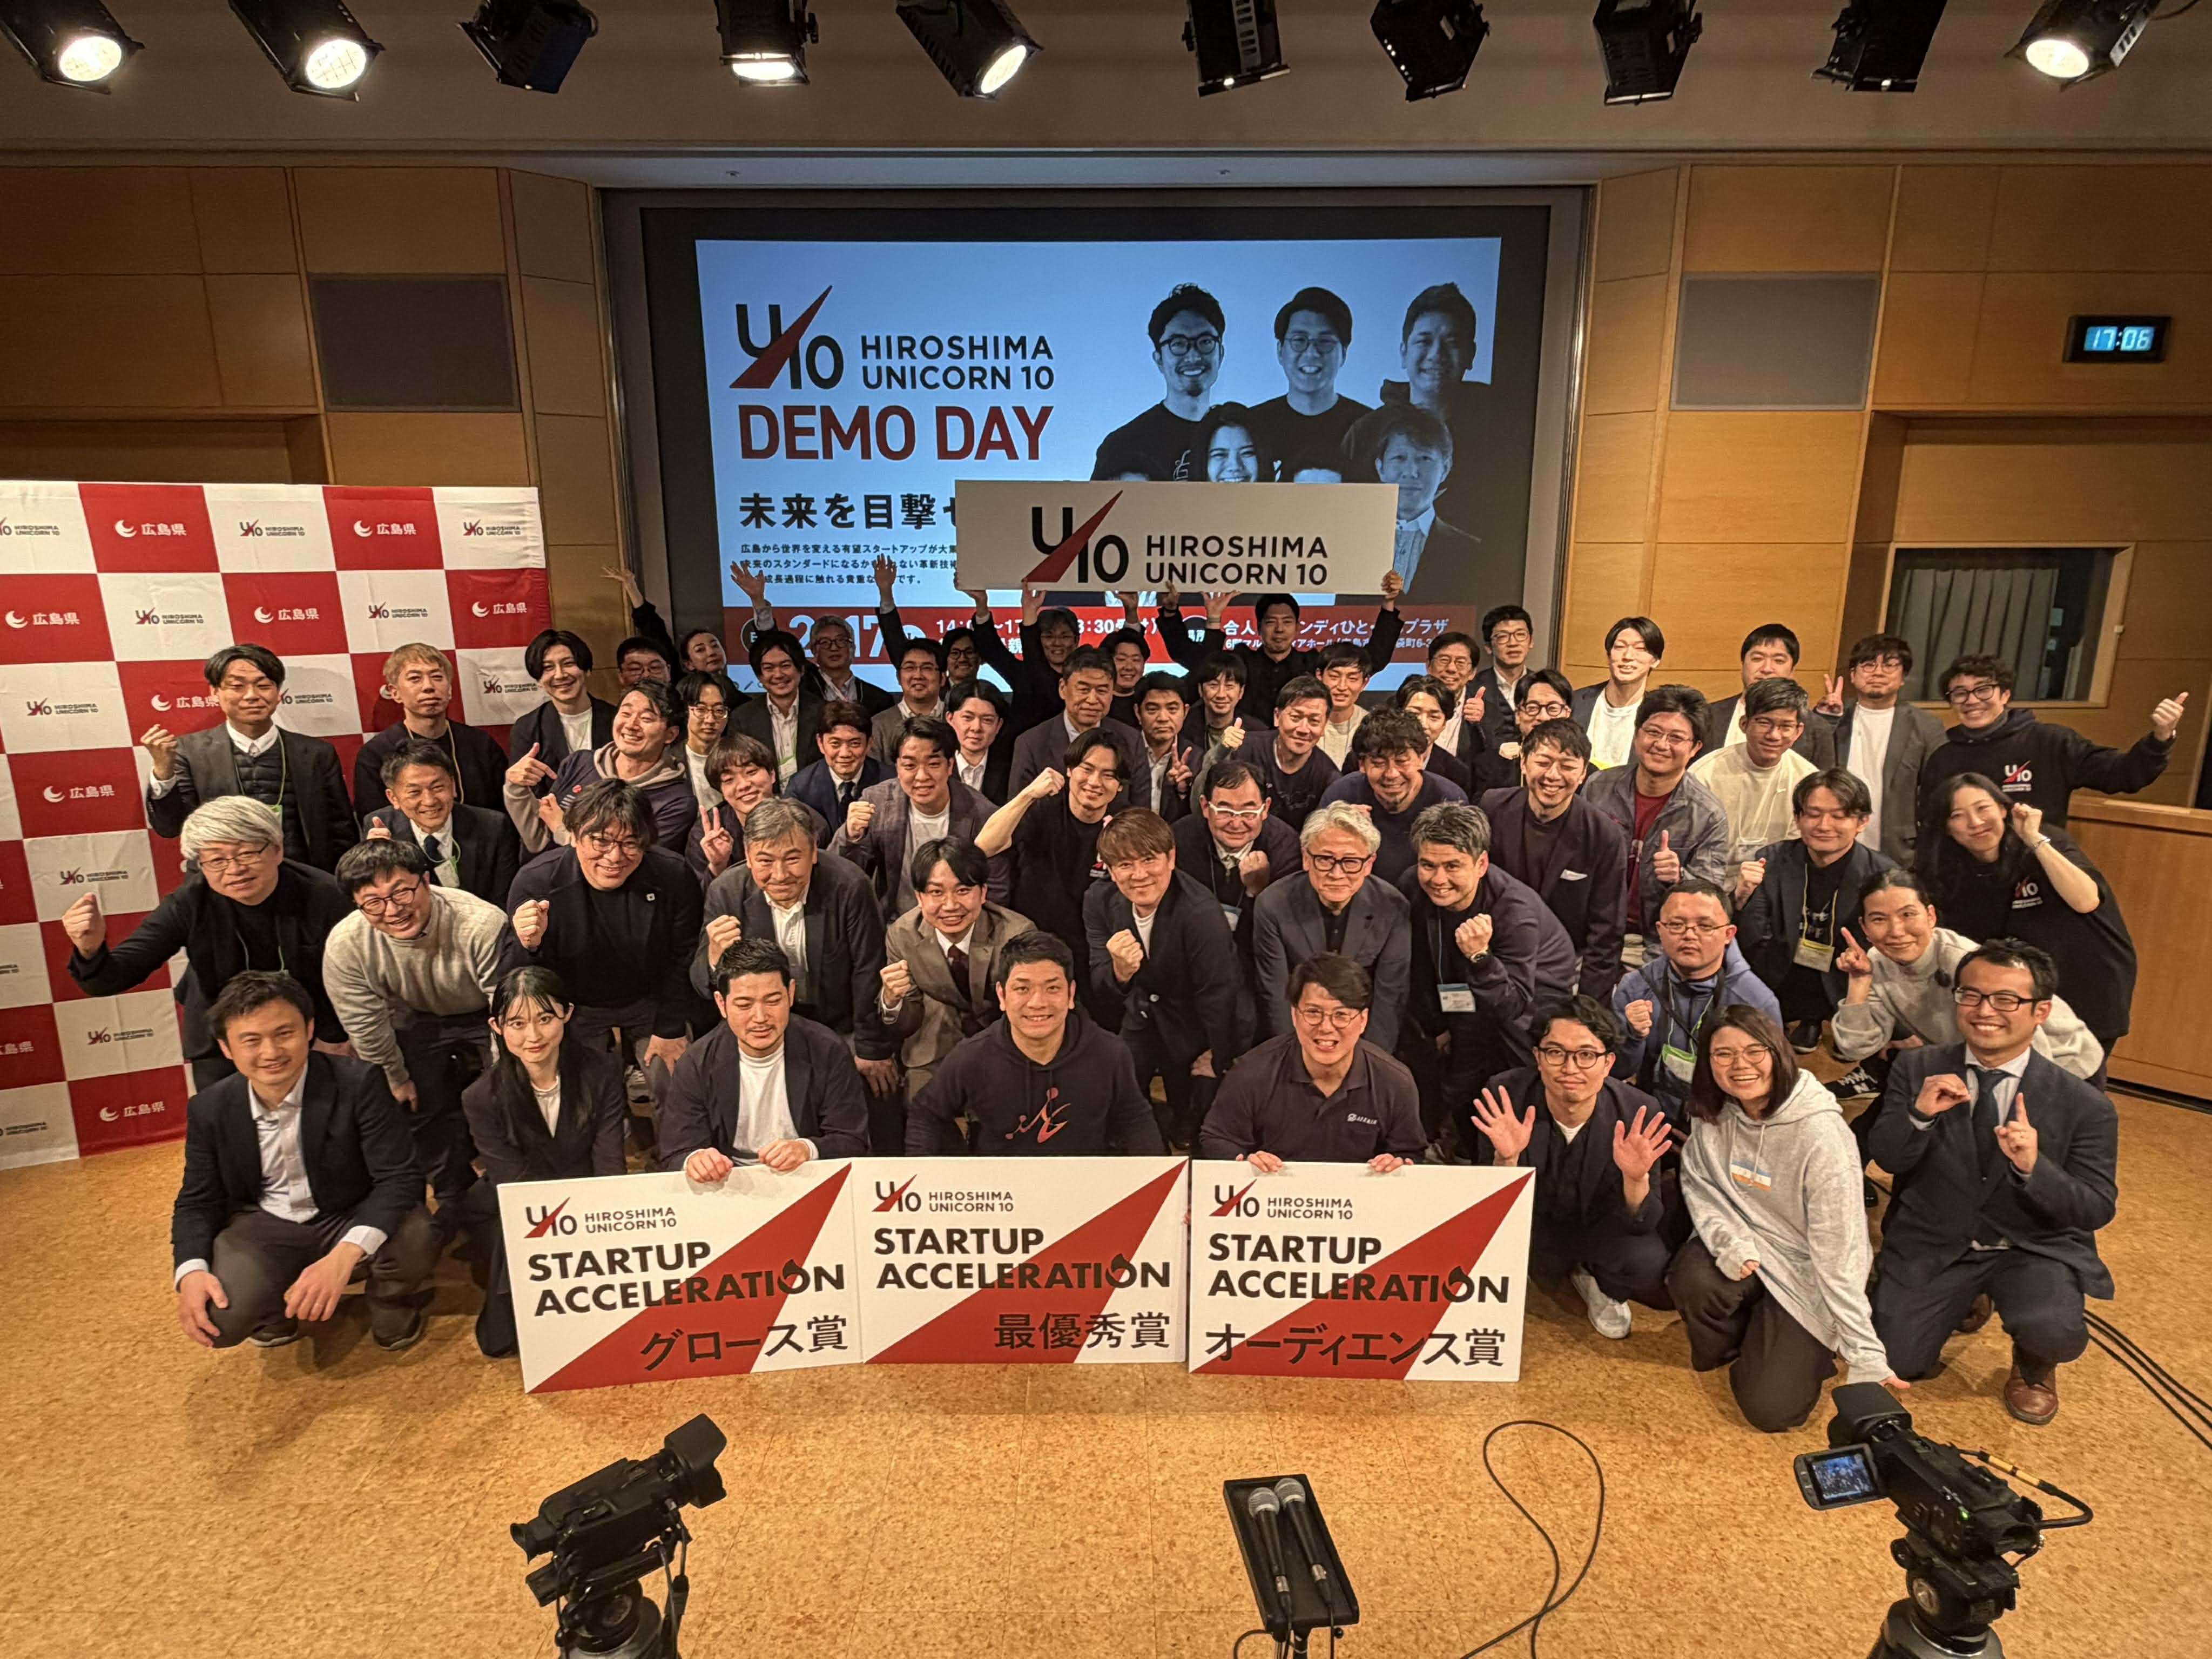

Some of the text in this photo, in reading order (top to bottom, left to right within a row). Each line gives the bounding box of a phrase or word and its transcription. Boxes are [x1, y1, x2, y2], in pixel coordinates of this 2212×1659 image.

[861, 335, 1053, 360] HIROSHIMA
[2092, 329, 2150, 350] 17:06
[862, 366, 1054, 390] UNICORN 10
[738, 404, 1054, 460] DEMO DAY
[141, 523, 187, 536] 広島県
[376, 523, 416, 535] 広島県
[1146, 535, 1328, 559] HIROSHIMA
[1146, 562, 1327, 585] UNICORN 10
[33, 612, 80, 625] 広島県
[278, 608, 319, 621] 広島県
[493, 602, 528, 614] 広島県
[70, 785, 115, 799] 広島県
[124, 1101, 165, 1117] 広島県
[929, 1191, 1013, 1201] HIROSHIMA
[929, 1202, 1014, 1212] UNICORN 10
[1267, 1197, 1353, 1208] HIROSHIMA
[585, 1207, 676, 1222] HIROSHIMA
[1267, 1209, 1353, 1220] UNICORN 10
[585, 1218, 677, 1234] UNICORN 10
[874, 1228, 1044, 1255] STARTUP
[1208, 1233, 1381, 1264] STARTUP
[529, 1242, 711, 1282] STARTUP
[876, 1253, 1170, 1289] ACCELERATION
[535, 1259, 844, 1317] ACCELERATION
[1208, 1266, 1509, 1304] ACCELERATION
[994, 1312, 1170, 1350] 最優秀賞
[640, 1315, 848, 1371] グロース賞
[1205, 1323, 1506, 1367] オーディエンス賞
